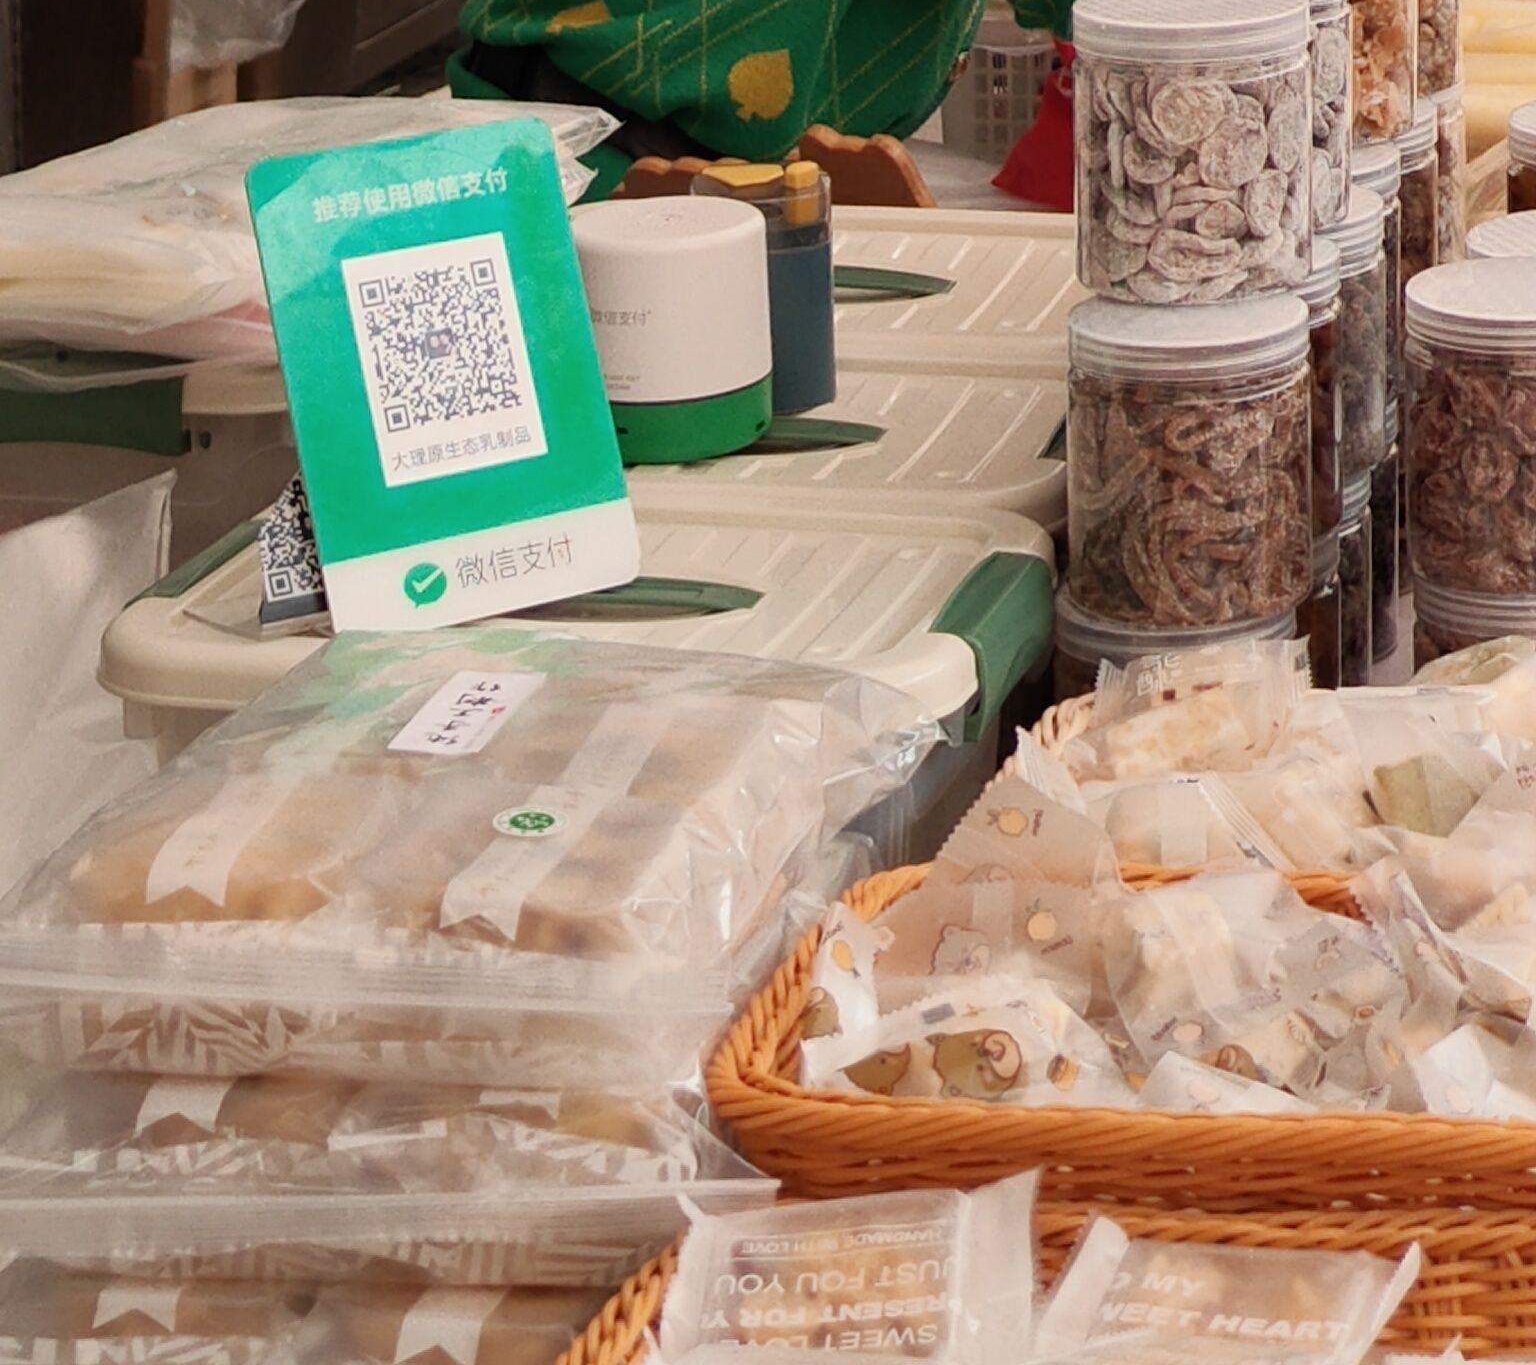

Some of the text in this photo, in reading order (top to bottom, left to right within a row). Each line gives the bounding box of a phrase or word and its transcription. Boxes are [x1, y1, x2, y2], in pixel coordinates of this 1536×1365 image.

[312, 167, 508, 223] 推荐使用微信支付
[391, 426, 532, 472] 大理原生态乳制品
[457, 533, 574, 588] 微信支付
[715, 1274, 785, 1297] YOU
[740, 1306, 809, 1329] FOR
[1208, 1314, 1350, 1340] HEART
[824, 1324, 939, 1351] SWEET
